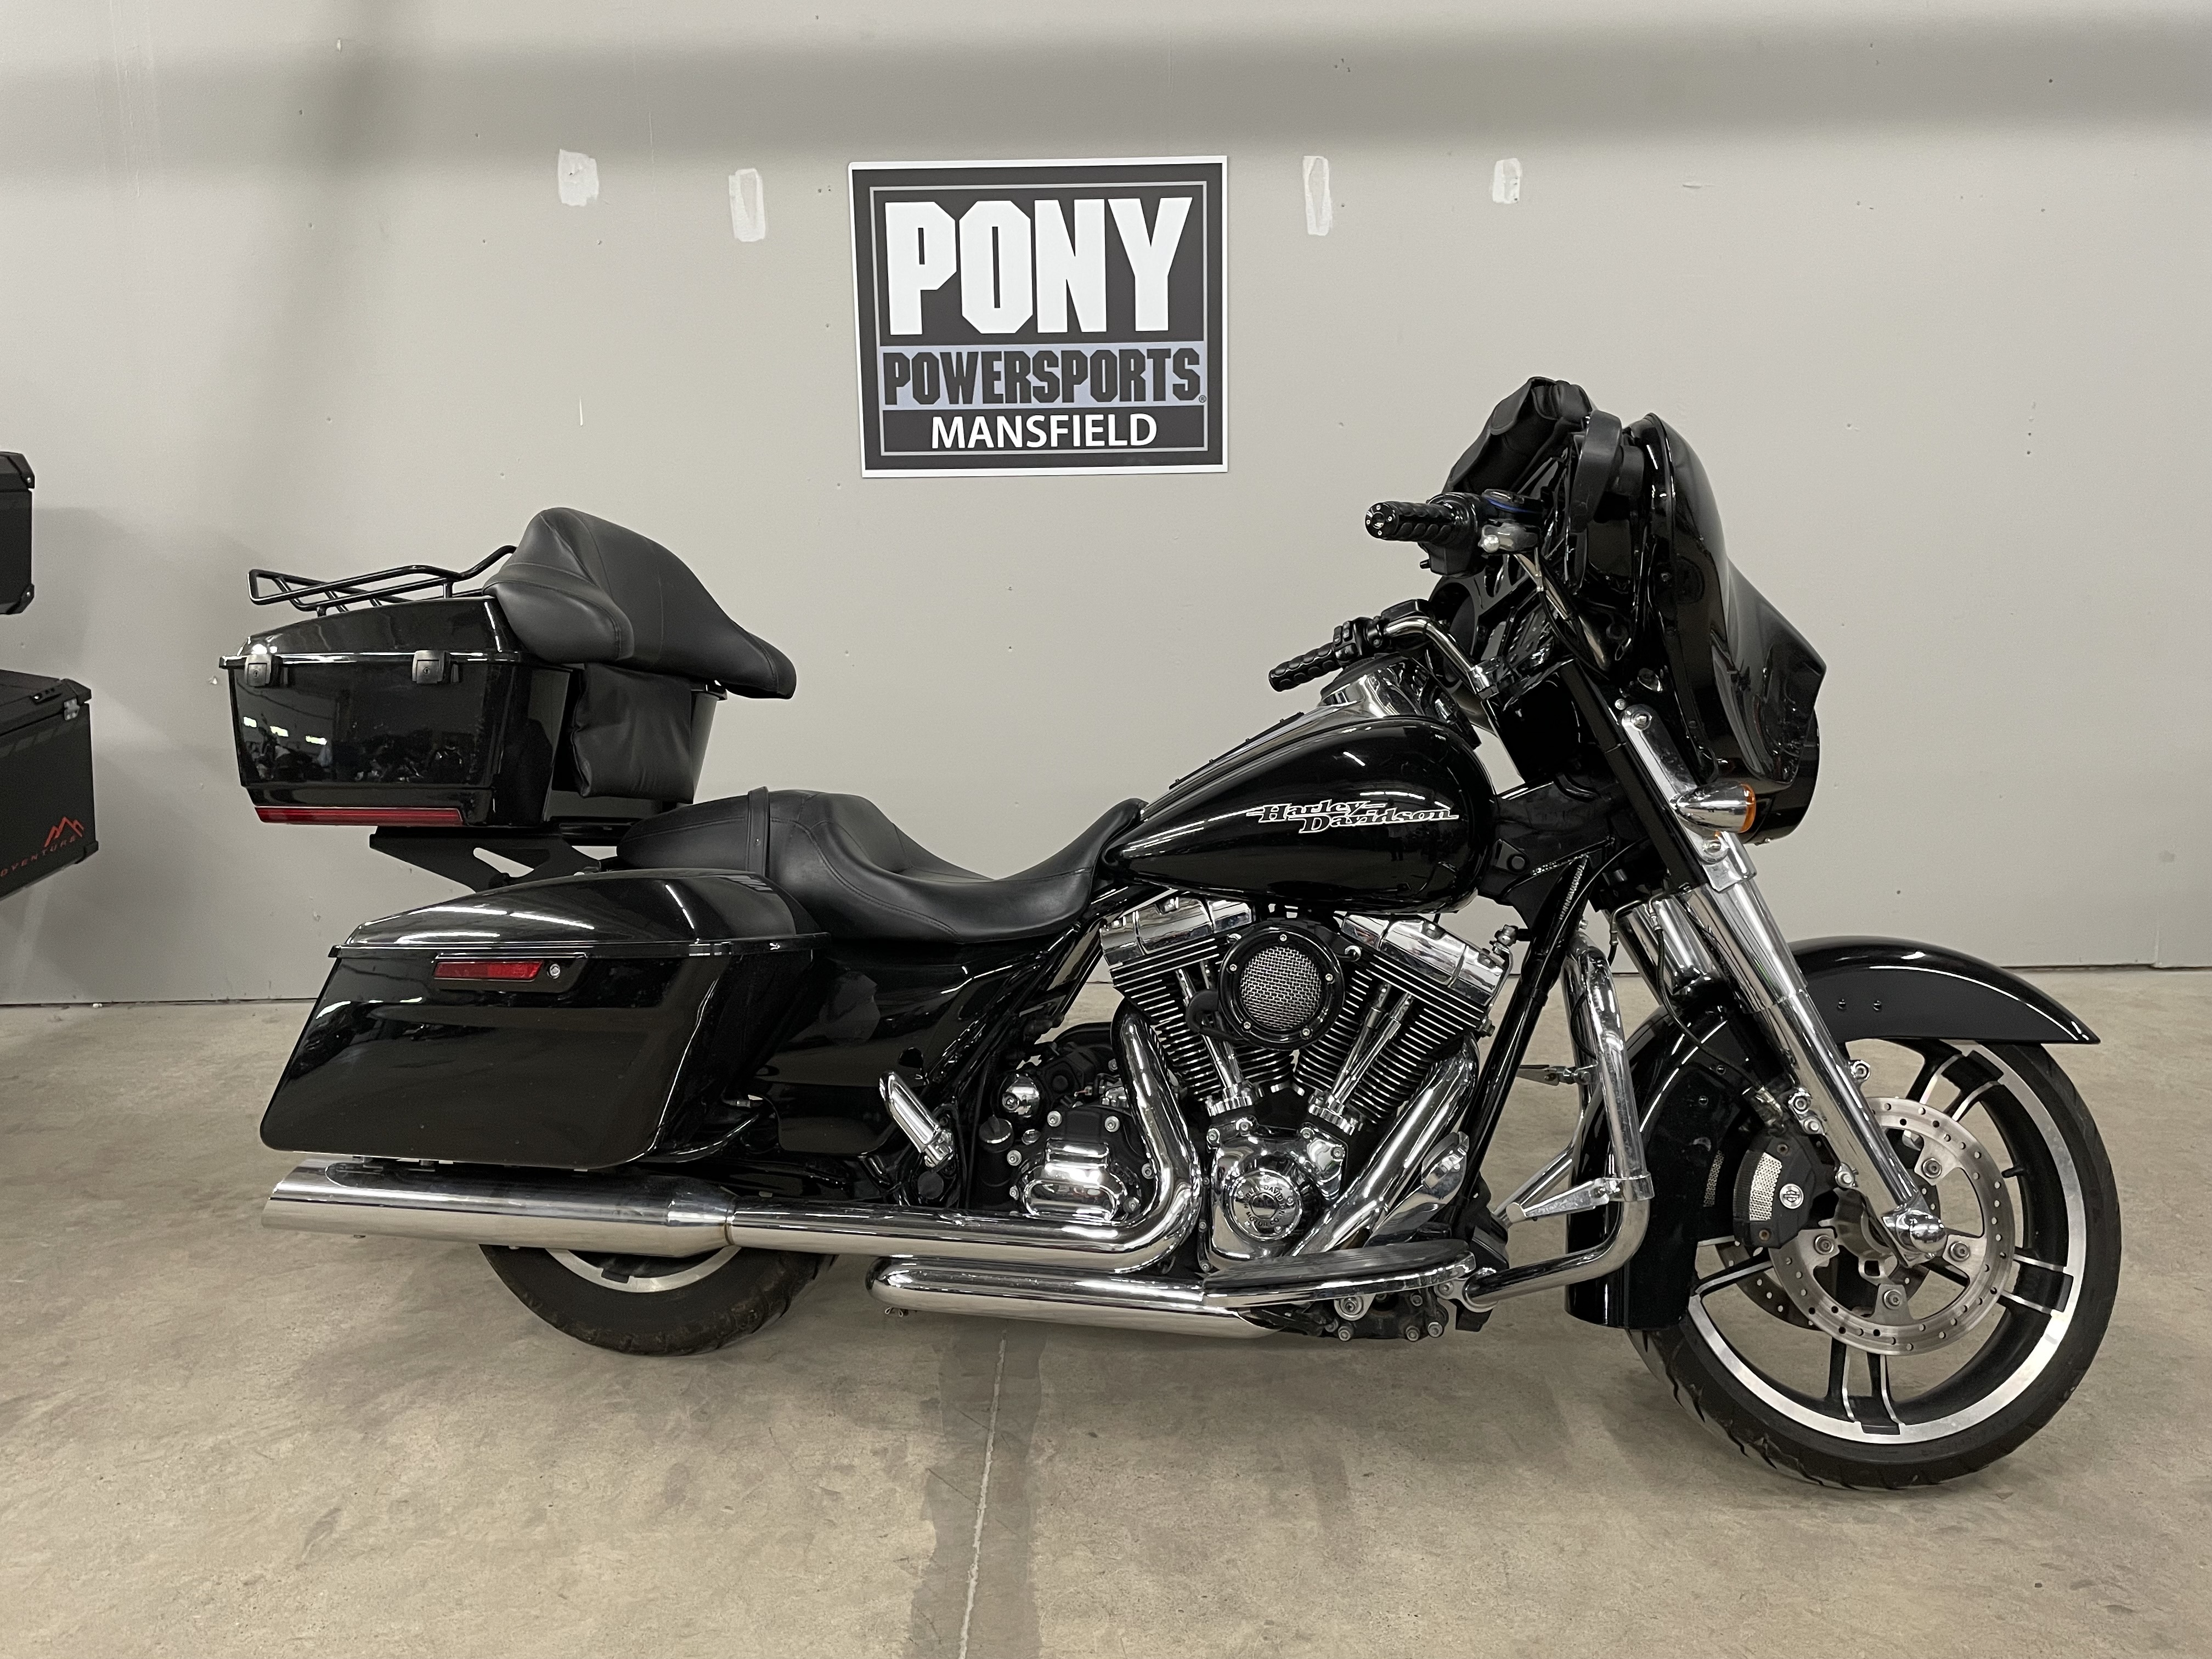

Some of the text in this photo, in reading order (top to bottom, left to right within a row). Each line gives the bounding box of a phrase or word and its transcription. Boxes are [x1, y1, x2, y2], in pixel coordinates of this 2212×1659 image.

[885, 197, 1193, 335] PONY
[932, 413, 1157, 449] MANSFIELD
[1287, 807, 1459, 834] Davidson
[0, 834, 77, 877] DVENTURE
